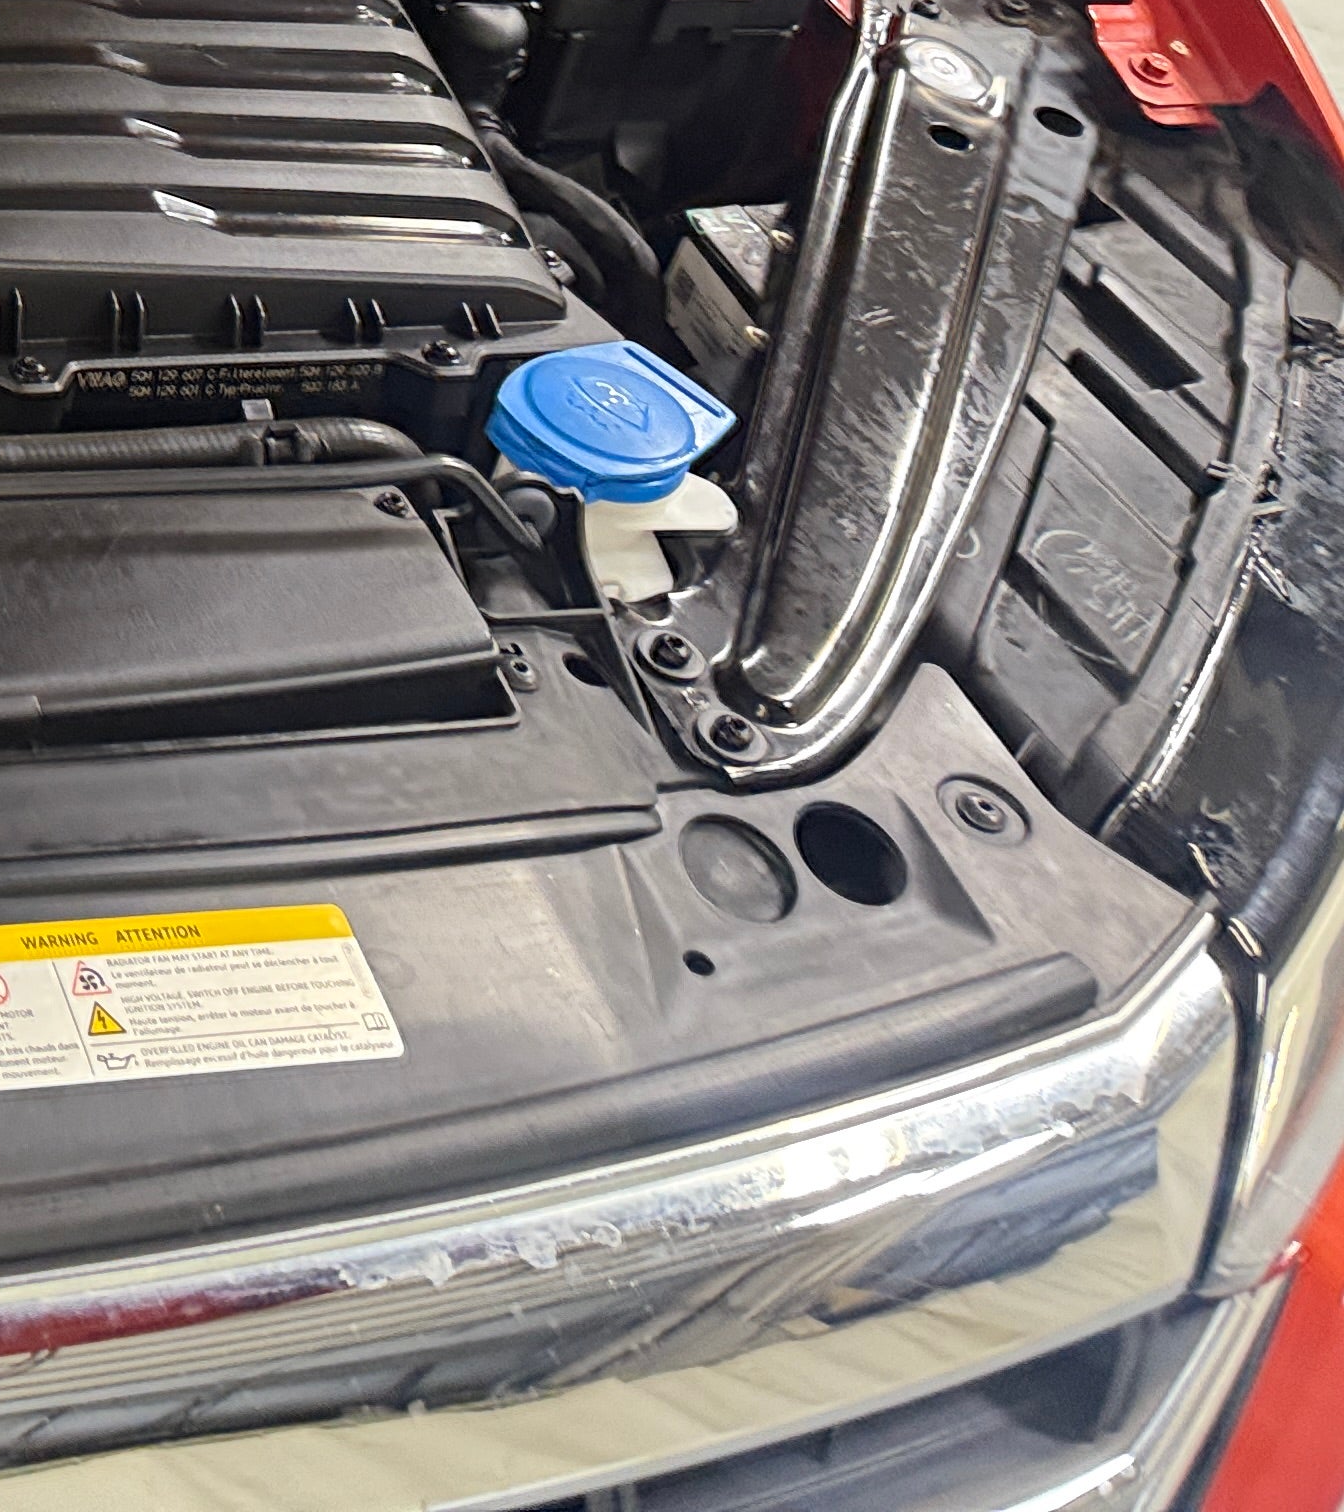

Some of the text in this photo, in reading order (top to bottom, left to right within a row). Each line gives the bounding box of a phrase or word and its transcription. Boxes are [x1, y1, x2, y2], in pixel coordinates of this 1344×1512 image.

[19, 924, 202, 951] WARNING ATTENTION
[106, 955, 151, 967] RADIATOR
[152, 953, 171, 964] FAN
[171, 952, 190, 963] MAY
[191, 950, 218, 961] START
[220, 949, 230, 958] AT
[232, 948, 249, 957] ANY
[111, 971, 123, 980] Le
[124, 966, 172, 979] ventilateur
[174, 965, 186, 975] de
[229, 961, 251, 973] peut
[251, 961, 263, 969] se
[319, 955, 339, 963] tout
[120, 995, 144, 1005] HIGH
[187, 988, 222, 999] SWITCH
[223, 986, 240, 997] OFF
[241, 984, 274, 996] ENGINE
[275, 981, 310, 993] BEFORE
[310, 978, 356, 990] TOUCHING
[0, 1008, 35, 1019] MOTOR
[124, 1004, 166, 1015] IGNITION
[128, 1016, 158, 1027] Haute
[229, 1009, 239, 1018] le
[240, 1007, 272, 1018] moteur
[274, 1004, 300, 1015] avant
[300, 1003, 313, 1013] de
[24, 1043, 57, 1054] chauds
[57, 1041, 80, 1051] dans
[140, 1042, 196, 1057] OVERFILLED
[196, 1039, 230, 1052] ENGINE
[231, 1038, 248, 1049] OIL
[248, 1037, 268, 1048] CAN
[268, 1033, 307, 1046] DAMAGE
[144, 1055, 202, 1069] Remplissage
[318, 1044, 339, 1056] pour
[340, 1042, 350, 1052] le
